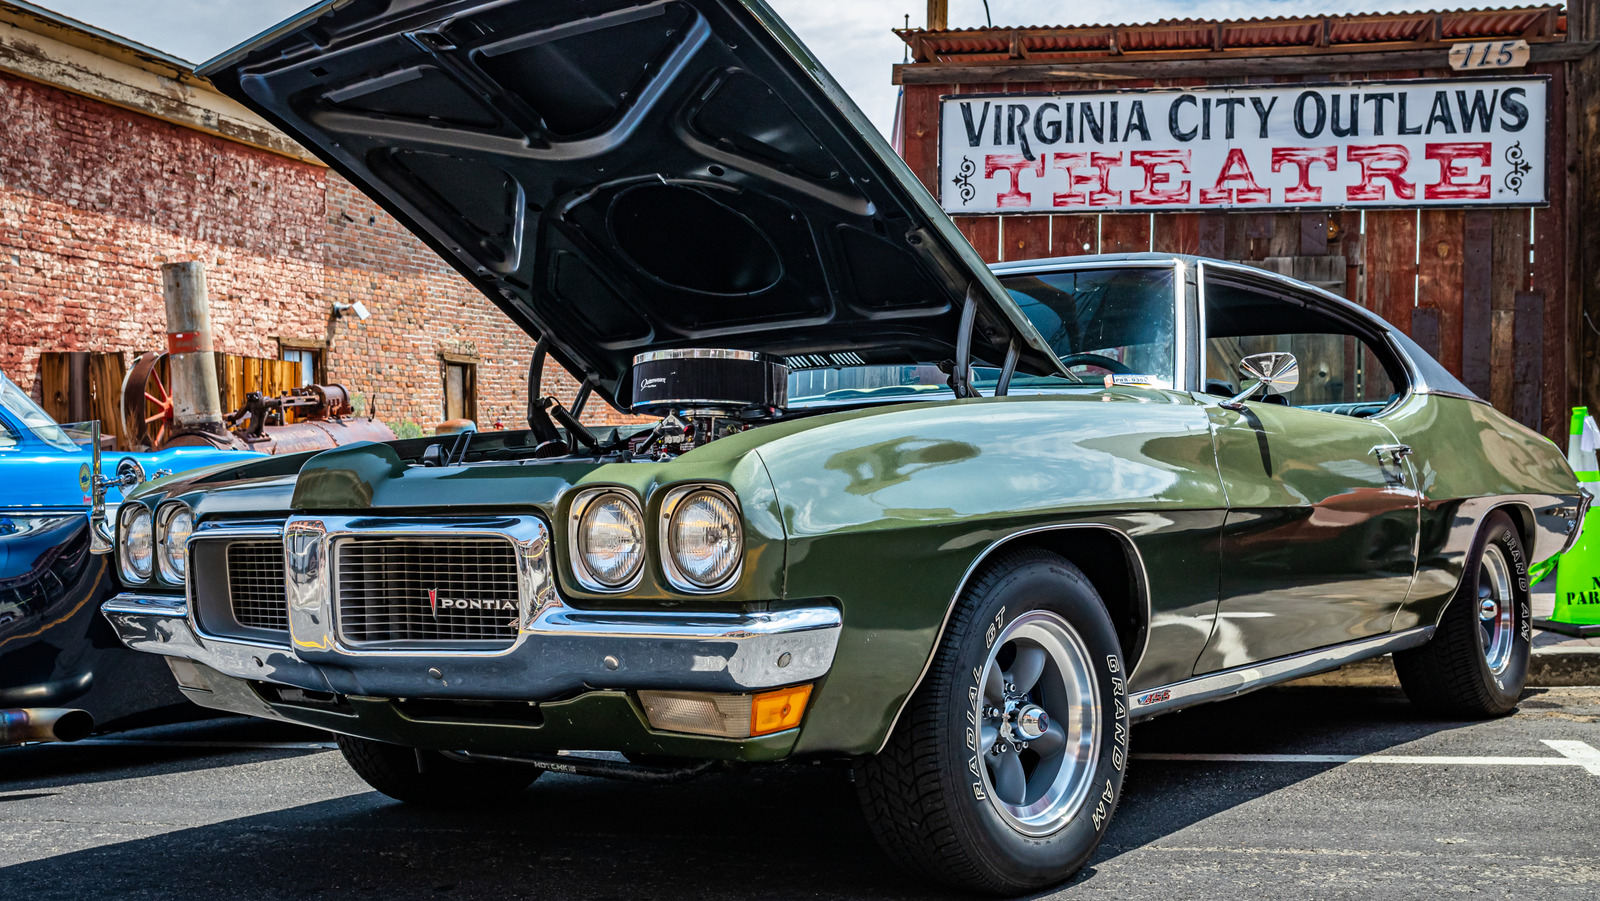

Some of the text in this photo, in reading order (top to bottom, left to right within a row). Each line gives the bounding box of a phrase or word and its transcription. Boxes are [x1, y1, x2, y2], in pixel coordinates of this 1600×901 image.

[1460, 43, 1515, 68] 115
[959, 87, 1529, 162] VIRGINIA CITY OUTLAWS
[984, 143, 1493, 207] THEATRE
[1502, 530, 1530, 642] GRAND AM
[1566, 591, 1600, 605] PAR
[1591, 576, 1600, 590] N
[966, 605, 1006, 801] RADIAL GT
[1144, 689, 1171, 704] 455
[1092, 654, 1126, 832] GRAND AM
